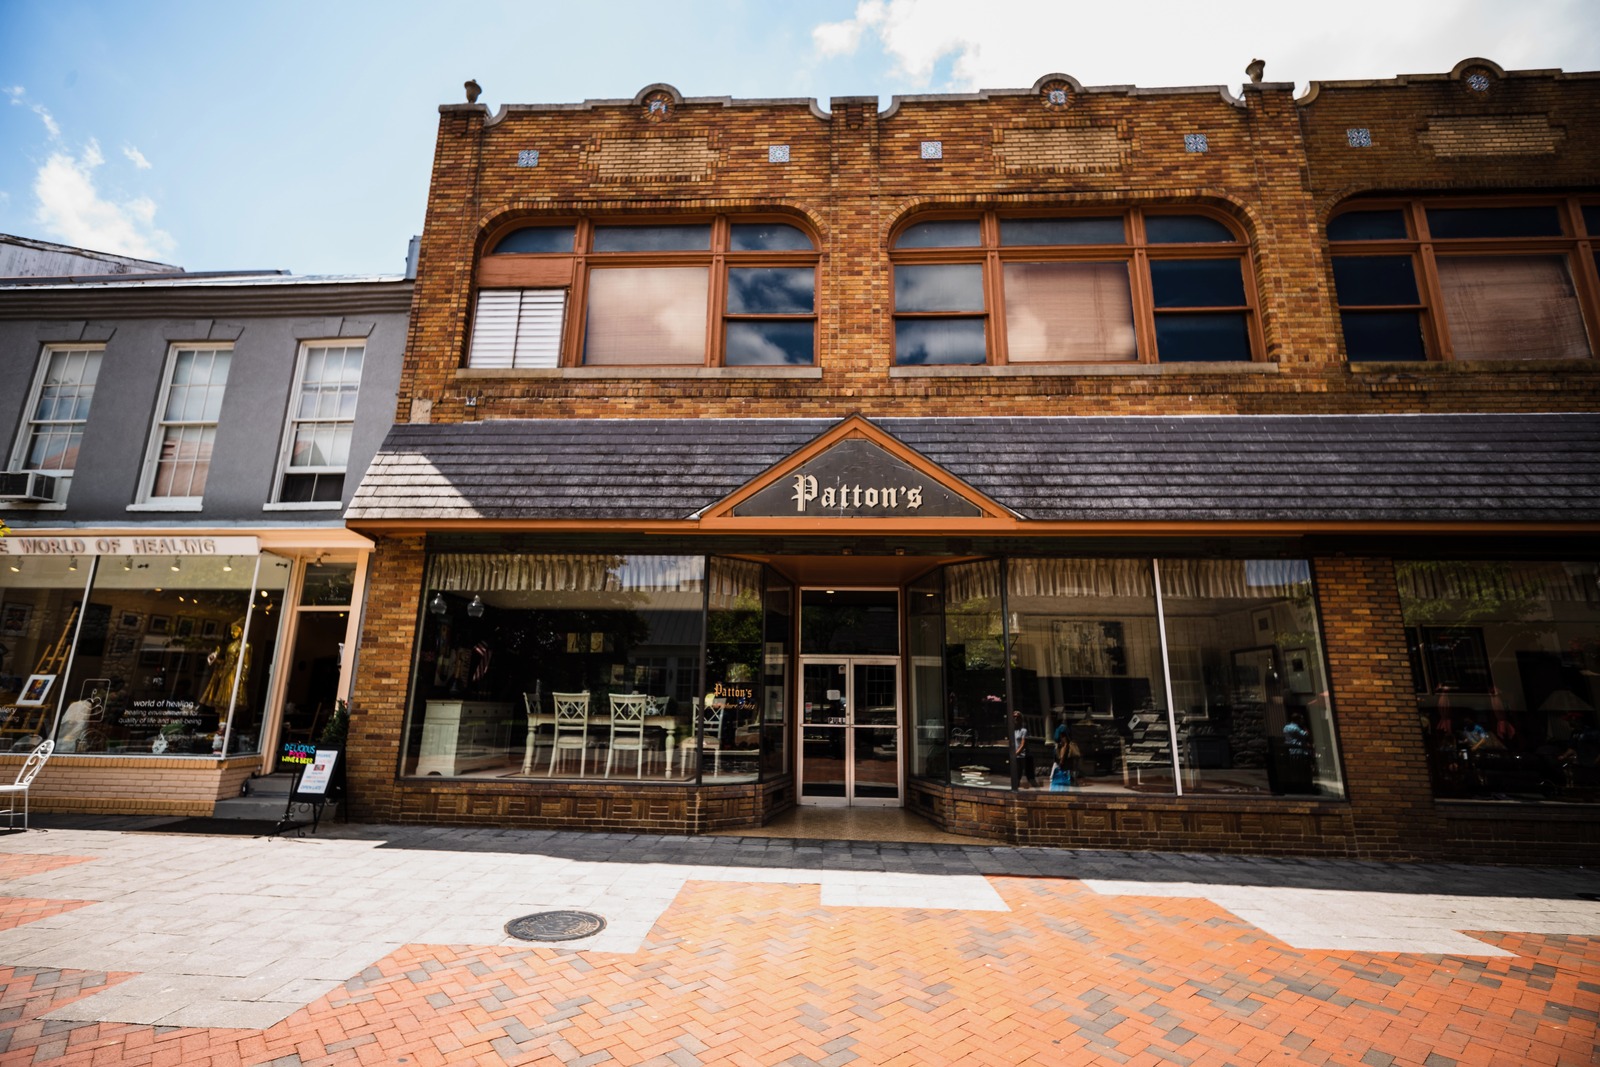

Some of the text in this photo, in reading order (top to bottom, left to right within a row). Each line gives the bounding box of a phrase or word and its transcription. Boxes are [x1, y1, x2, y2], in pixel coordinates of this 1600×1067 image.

[791, 474, 923, 511] Patton's
[18, 538, 86, 554] WORLD
[95, 538, 121, 554] OF
[132, 538, 216, 554] HEALING
[714, 682, 753, 698] Patton's
[133, 700, 194, 709] world of healing
